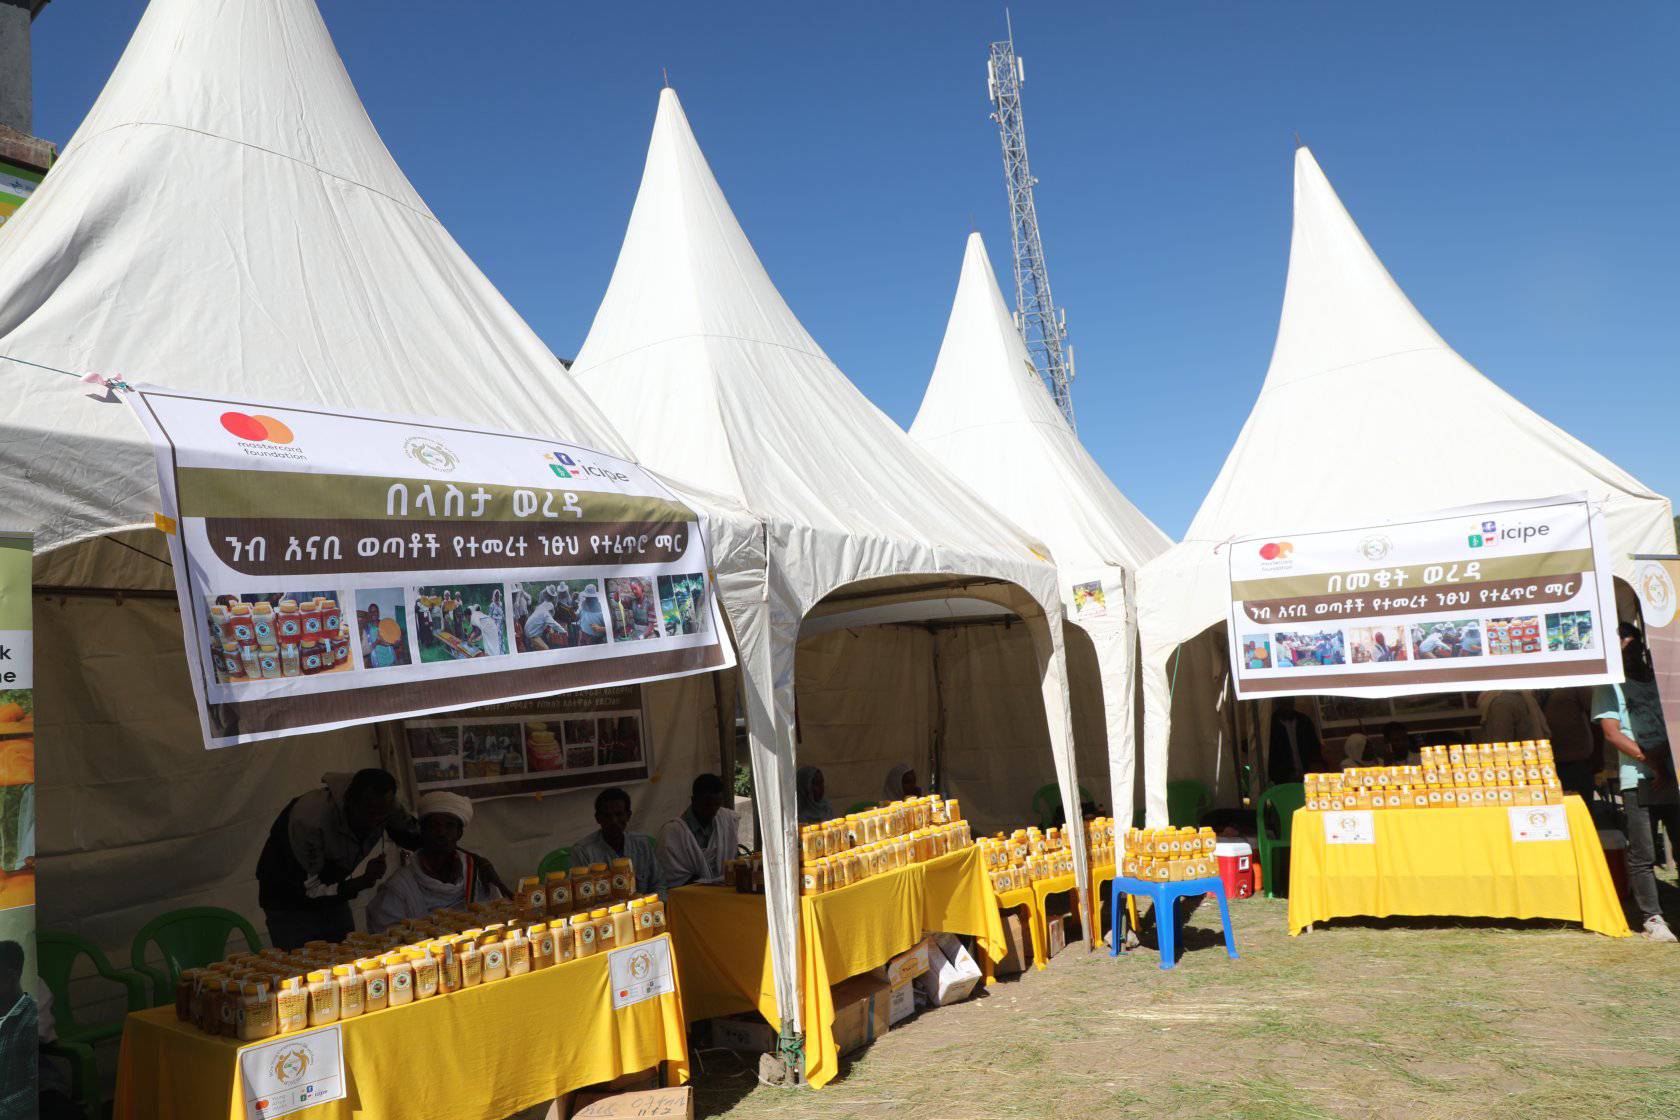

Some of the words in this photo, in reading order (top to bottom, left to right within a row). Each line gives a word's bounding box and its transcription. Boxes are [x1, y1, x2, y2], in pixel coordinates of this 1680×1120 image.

[237, 442, 303, 454] mastercard
[244, 448, 308, 460] foundation
[577, 459, 630, 483] icipe
[386, 483, 492, 517] በላስታ
[513, 489, 583, 518] ወረዳ
[1501, 521, 1550, 543] icipe
[225, 536, 266, 561] ንብ
[284, 535, 343, 561] አናቢ
[357, 532, 441, 559] ወጣቶች
[453, 535, 528, 558] የተመረተ
[538, 535, 579, 556] ንፁህ
[590, 534, 649, 554] የተፈጥሮ
[655, 534, 682, 553] ማር
[1423, 561, 1481, 585] ወረዳ
[1251, 607, 1271, 619] ንብ
[1278, 604, 1308, 618] አናቢ
[1314, 598, 1365, 614] ወጣቶች
[1372, 595, 1429, 611] የተመረተ
[1544, 581, 1575, 596] ማር
